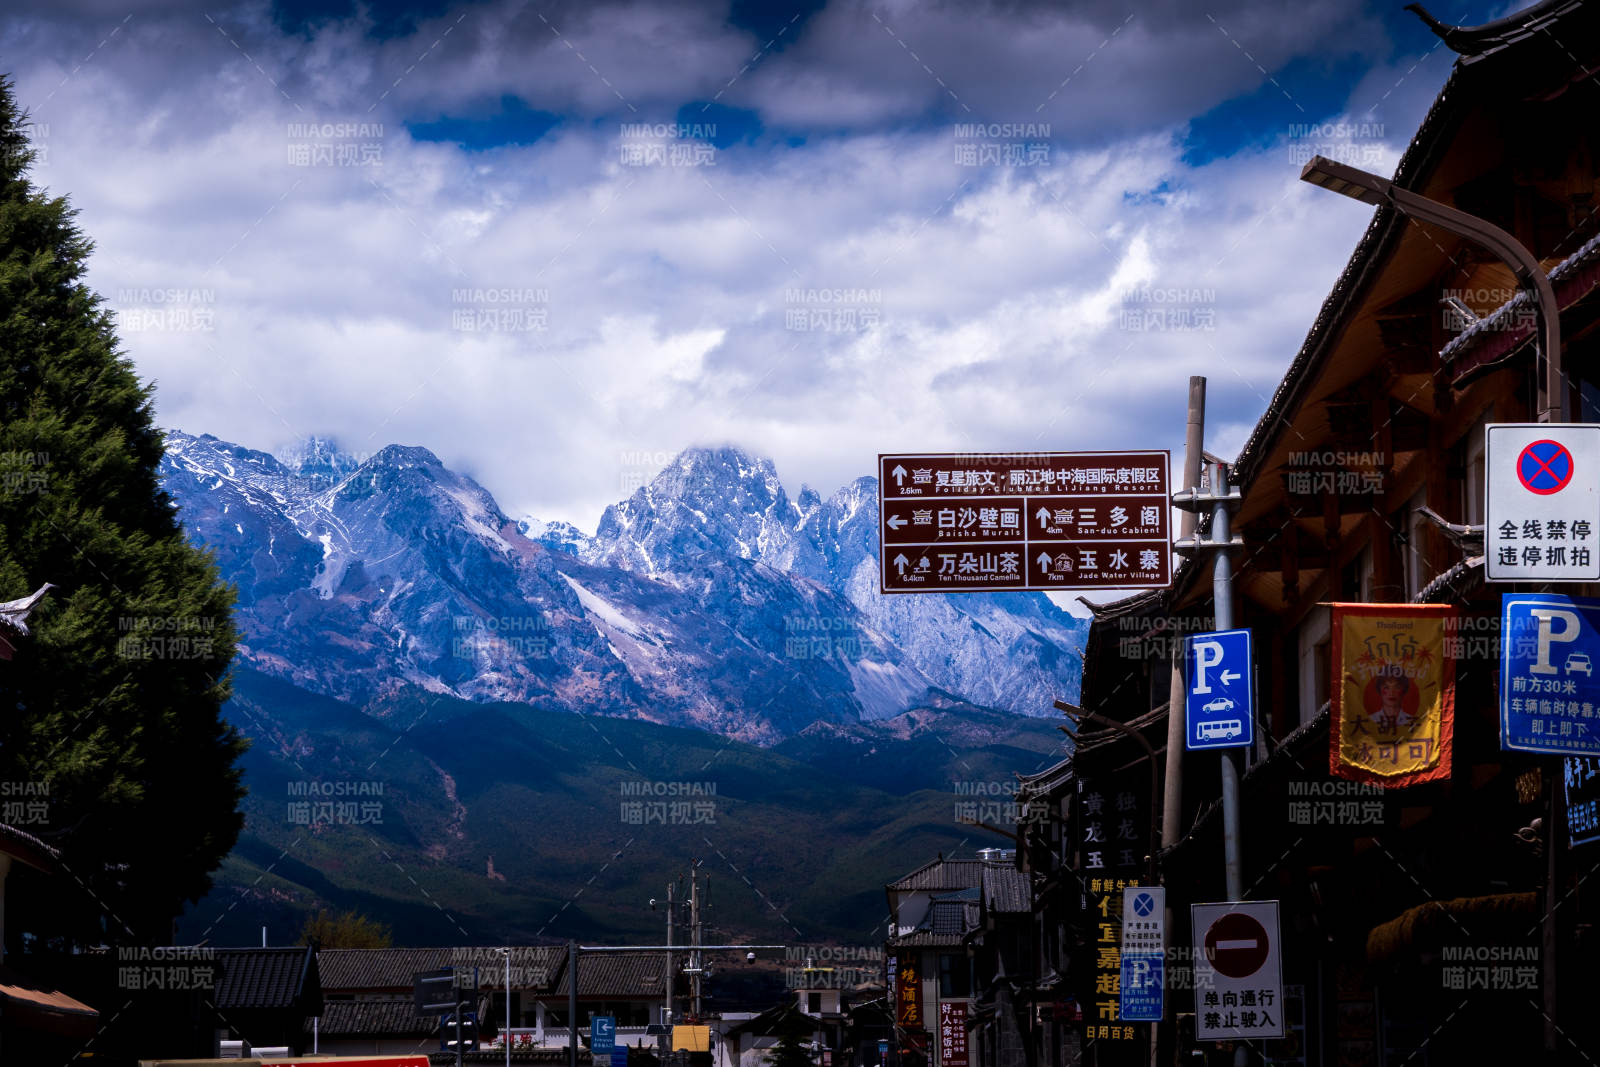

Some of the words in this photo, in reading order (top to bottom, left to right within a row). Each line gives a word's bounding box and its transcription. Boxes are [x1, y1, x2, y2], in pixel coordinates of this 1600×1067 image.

[935, 467, 1160, 487] 复星旅文·丽江地中海国际度假区
[900, 487, 922, 495] 2.6km
[1057, 485, 1106, 493] LiJiang
[938, 507, 1020, 529] 白沙壁画
[1078, 506, 1160, 527] 三多阁
[1498, 519, 1592, 541] 全线禁停
[938, 552, 1020, 574] 万朵山茶
[1078, 549, 1160, 570] 玉水寨
[1498, 545, 1591, 567] 违停抓拍
[938, 574, 952, 582] Ten
[989, 573, 1020, 581] Camellia
[1047, 573, 1064, 581] 7km
[1376, 621, 1413, 630] Thailand
[1529, 608, 1581, 675] P
[1512, 675, 1577, 695] 前方30米
[1531, 719, 1586, 738] 即上即下
[1204, 989, 1274, 1008] 单向通行
[1204, 1010, 1276, 1030] 禁止驶入
[942, 1003, 953, 1059] 好人家饭店
[1086, 1026, 1135, 1040] 日用百货
